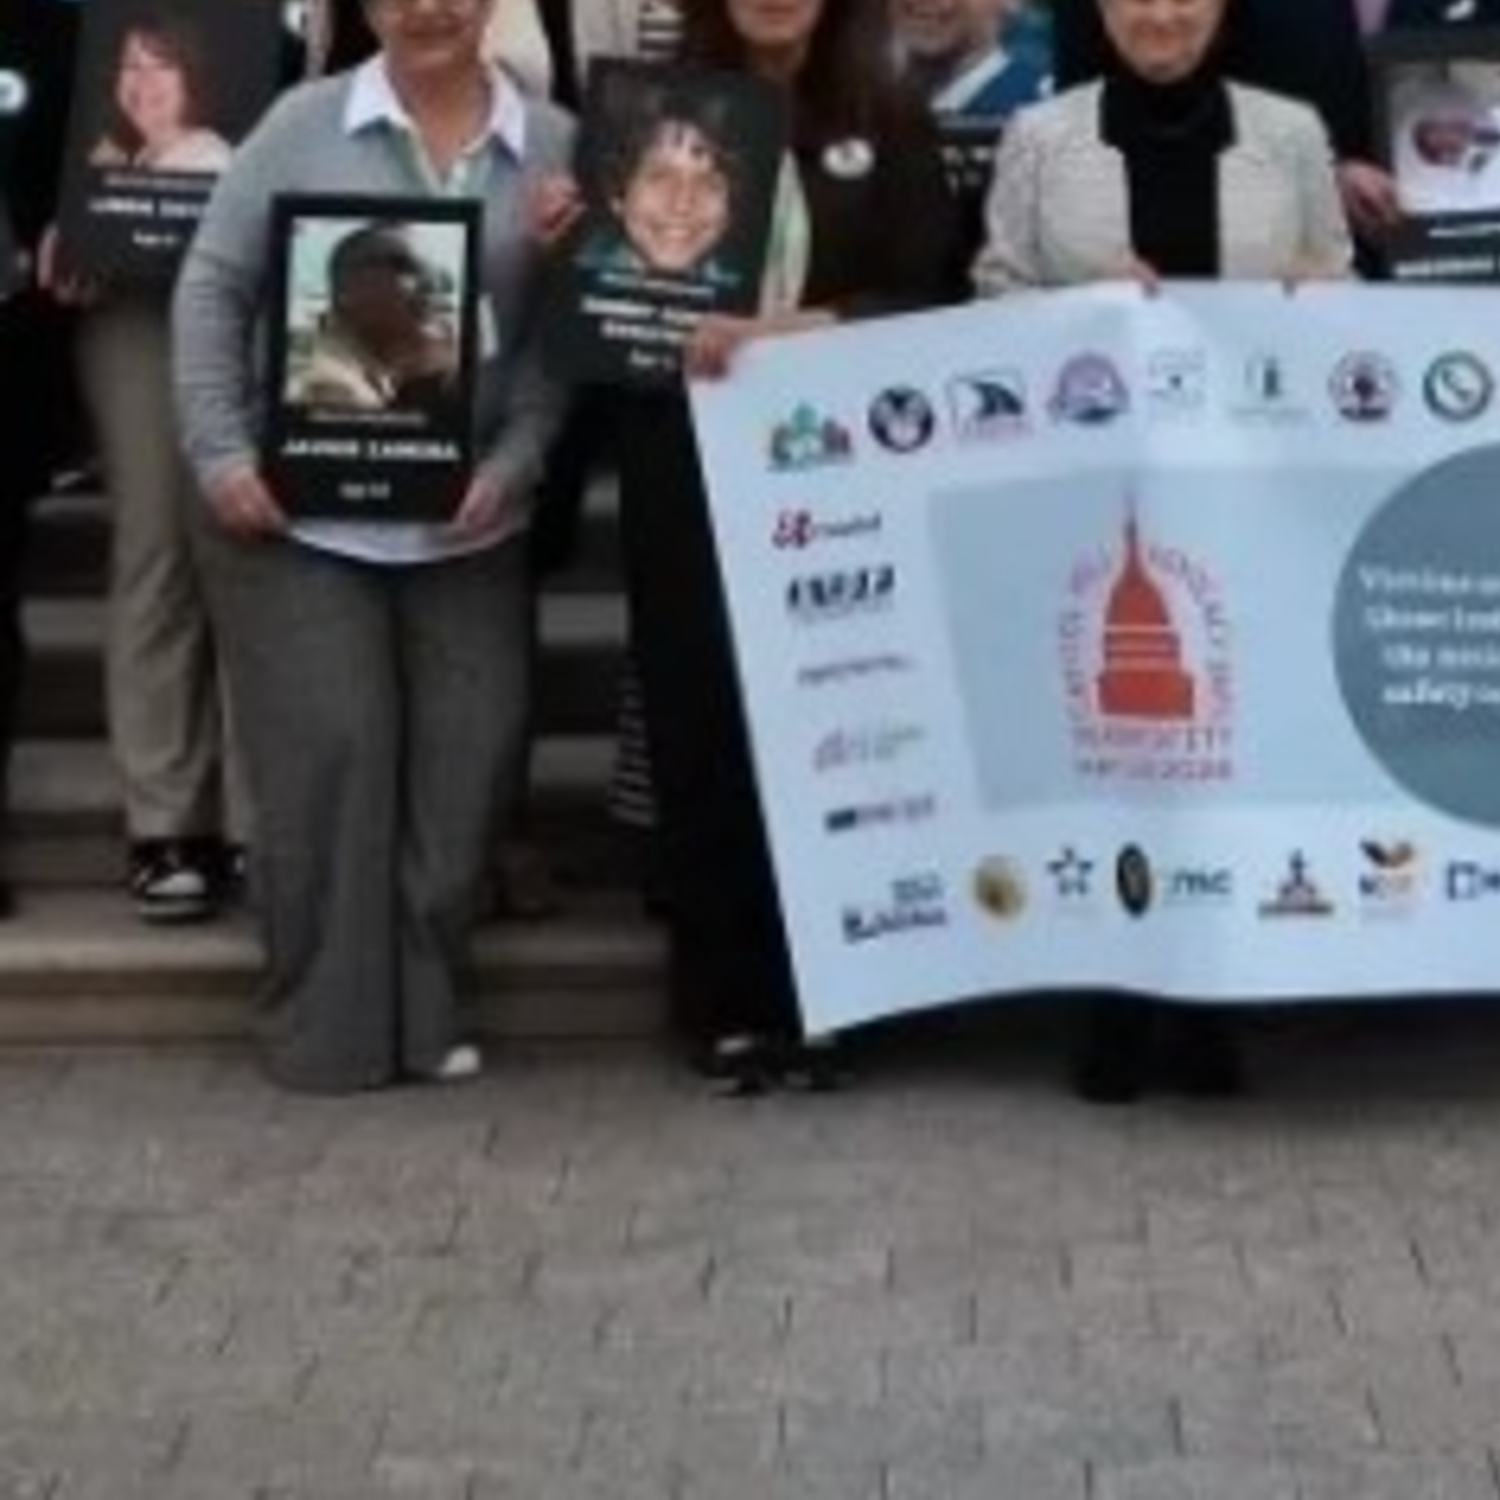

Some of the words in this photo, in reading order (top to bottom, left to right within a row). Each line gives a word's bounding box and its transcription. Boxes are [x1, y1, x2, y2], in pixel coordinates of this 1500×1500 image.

[1358, 568, 1471, 594] Victims
[1366, 605, 1449, 631] those
[1384, 643, 1431, 669] the
[1384, 677, 1470, 711] safety
